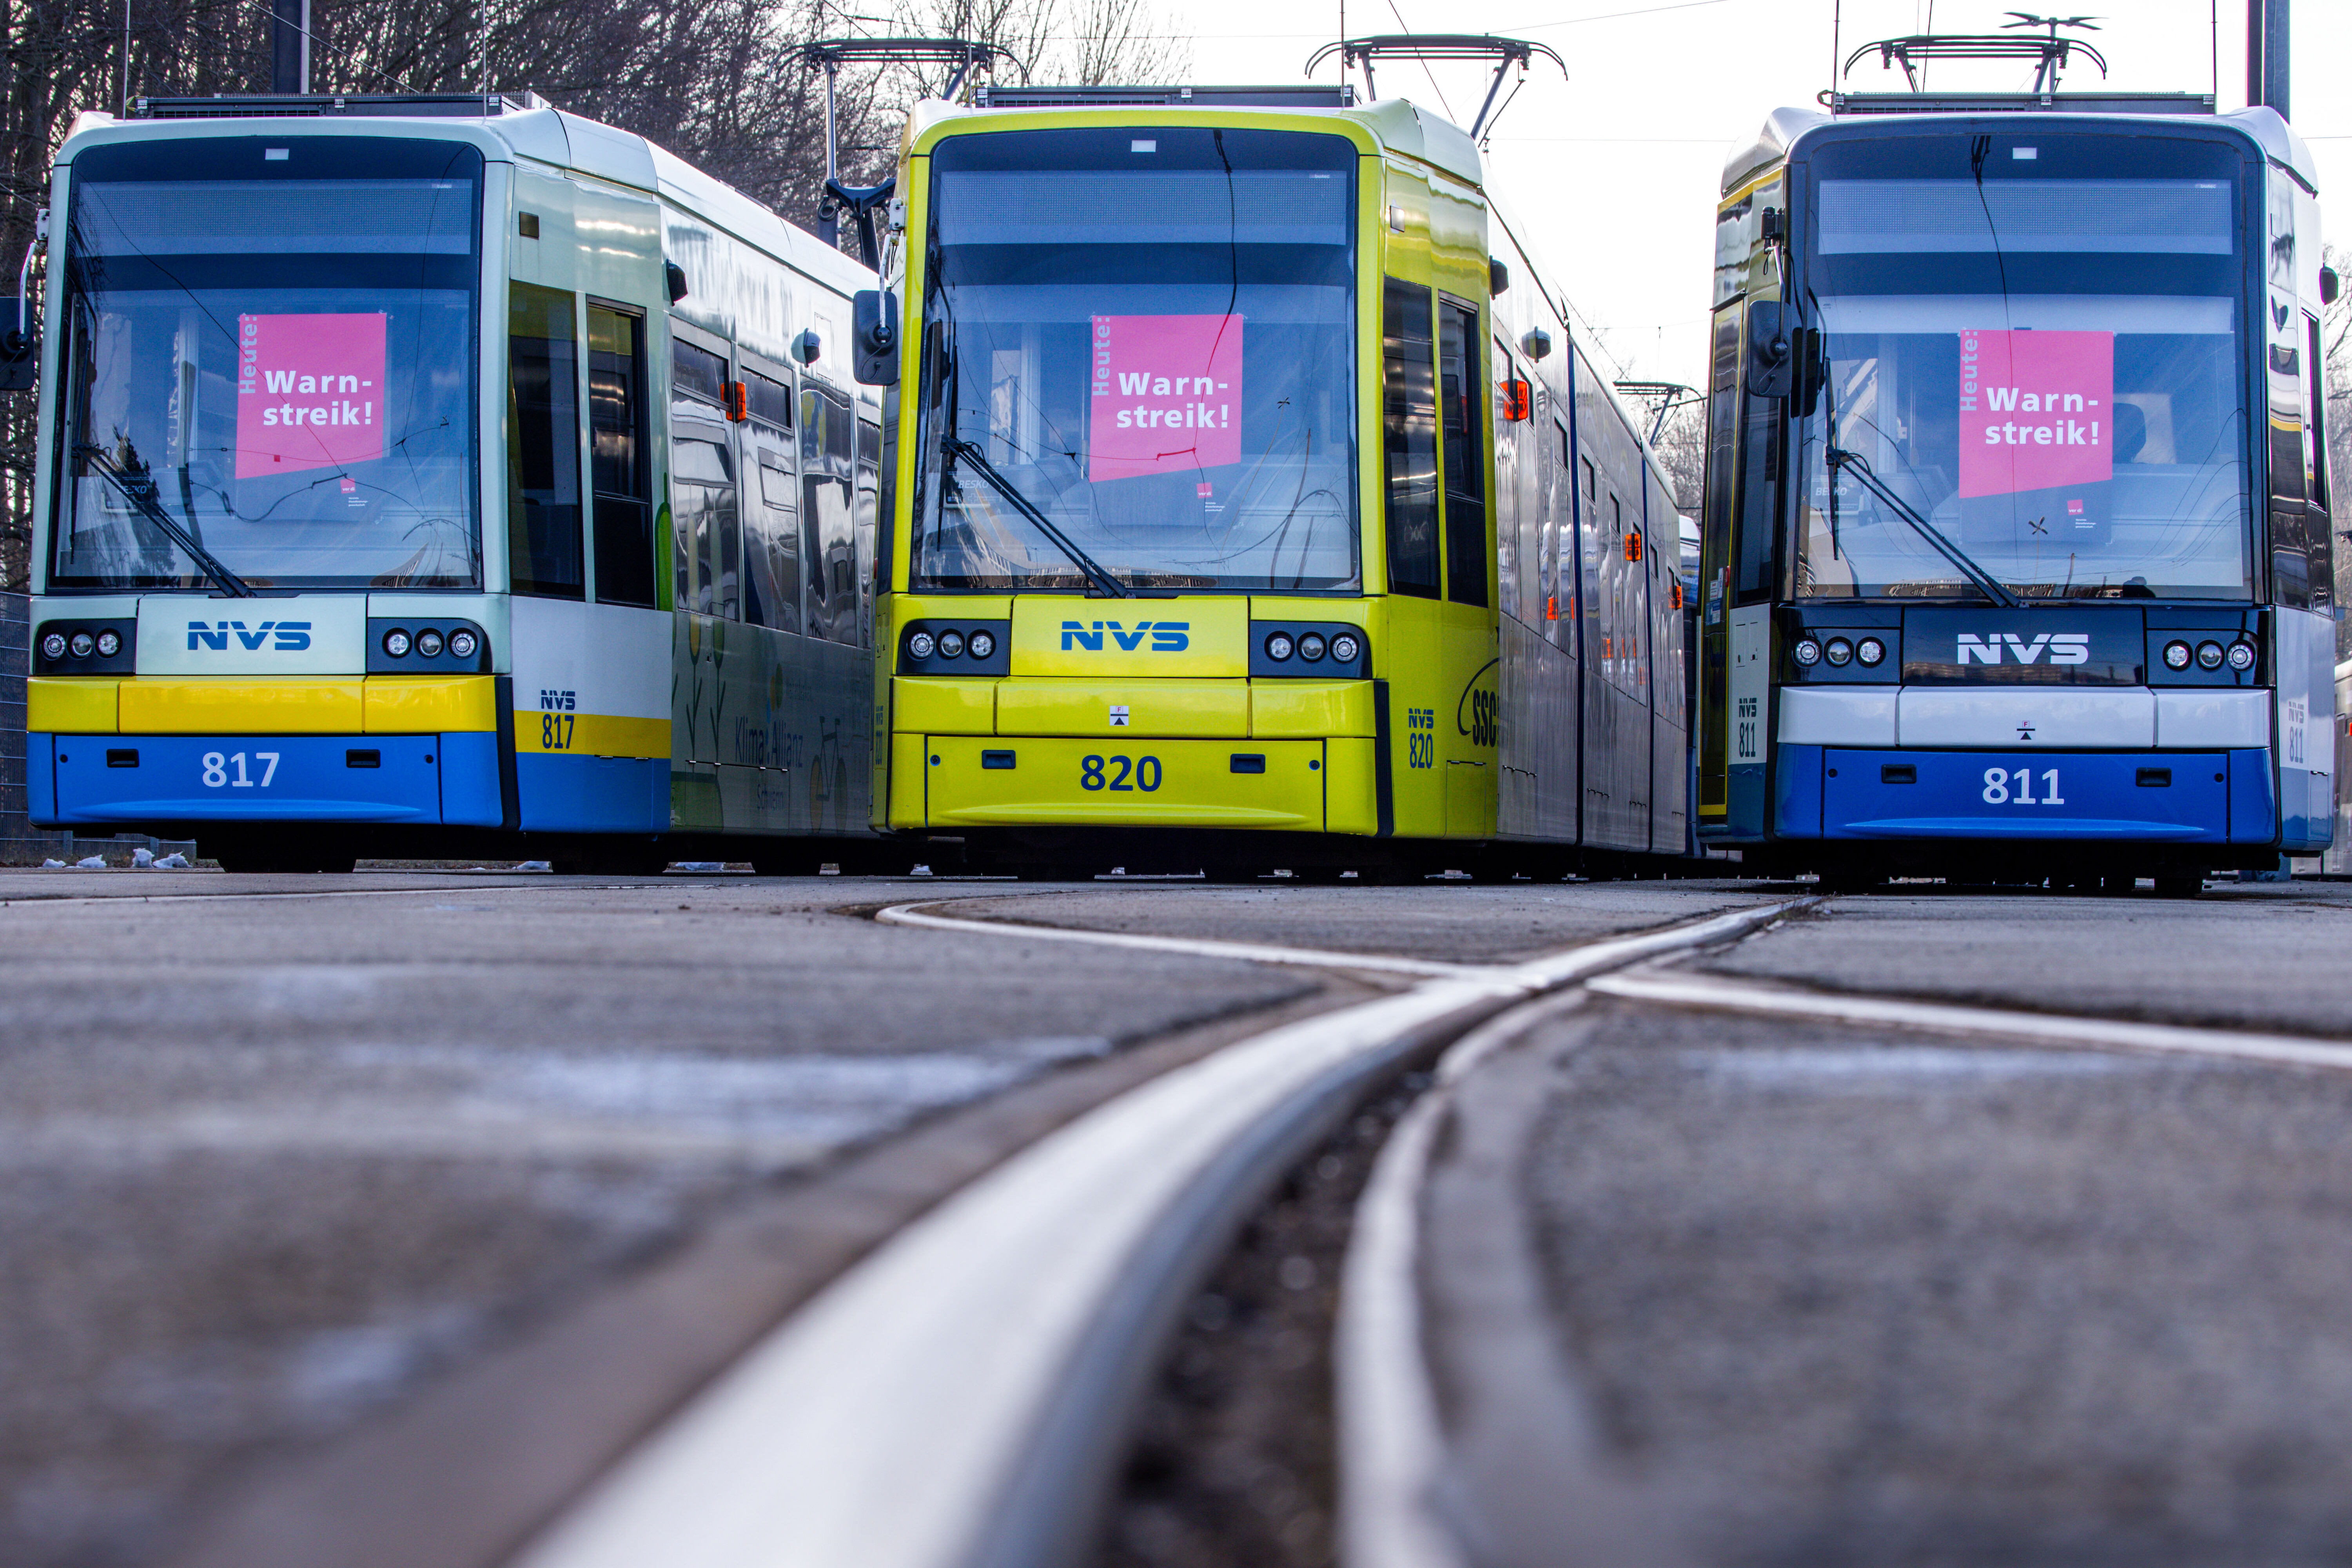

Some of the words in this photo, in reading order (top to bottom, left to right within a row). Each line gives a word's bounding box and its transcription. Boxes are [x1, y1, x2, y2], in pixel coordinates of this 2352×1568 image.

[240, 316, 257, 394] Heute:
[1093, 317, 1110, 396] Heute:
[1960, 330, 1978, 411] Heute:
[265, 370, 372, 394] Warn-
[1118, 372, 1228, 396] Warn-
[263, 400, 372, 425] streik!
[1117, 403, 1228, 428] streik!
[1986, 388, 2098, 412] Warn-
[1985, 420, 2098, 445] streik!
[958, 480, 989, 488] BESKO
[1815, 487, 1847, 495] BEKO
[187, 621, 312, 651] NVS
[1061, 621, 1190, 652] NVS
[1958, 633, 2089, 664] NVS
[541, 690, 575, 710] NVS
[1739, 697, 1757, 717] NVS
[2288, 701, 2304, 724] NVS
[542, 713, 574, 749] 817
[1408, 708, 1434, 729] NVS
[1472, 688, 1497, 748] SSC
[735, 715, 764, 765] Klima
[771, 719, 803, 768] Allianz
[1409, 732, 1434, 769] 820
[1739, 722, 1756, 758] 811
[2289, 726, 2304, 764] 811
[202, 752, 279, 787] 817
[1080, 755, 1163, 792] 820
[1983, 768, 2065, 804] 811
